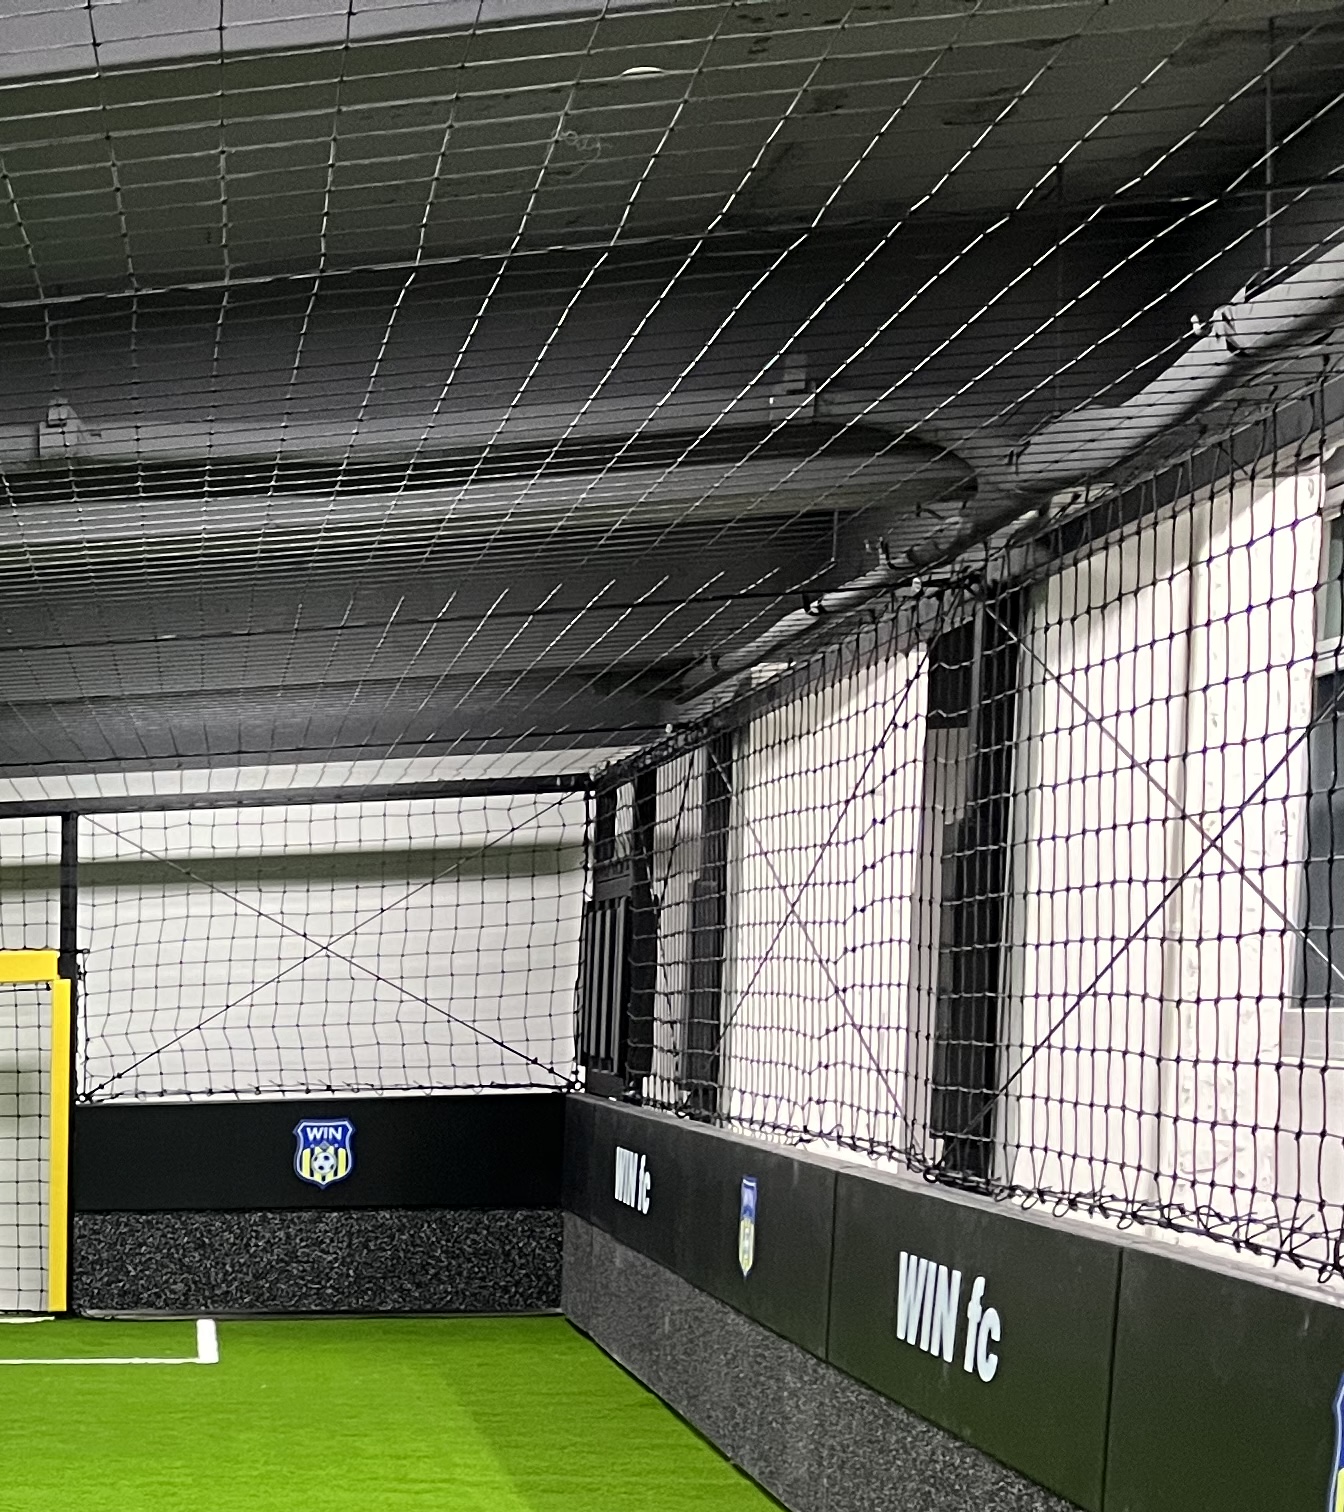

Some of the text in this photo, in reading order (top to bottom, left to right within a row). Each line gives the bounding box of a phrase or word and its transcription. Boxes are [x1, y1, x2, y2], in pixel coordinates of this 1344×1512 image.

[306, 1126, 342, 1141] WIN
[637, 1154, 651, 1214] fc
[896, 1250, 1001, 1382] WIN fc
